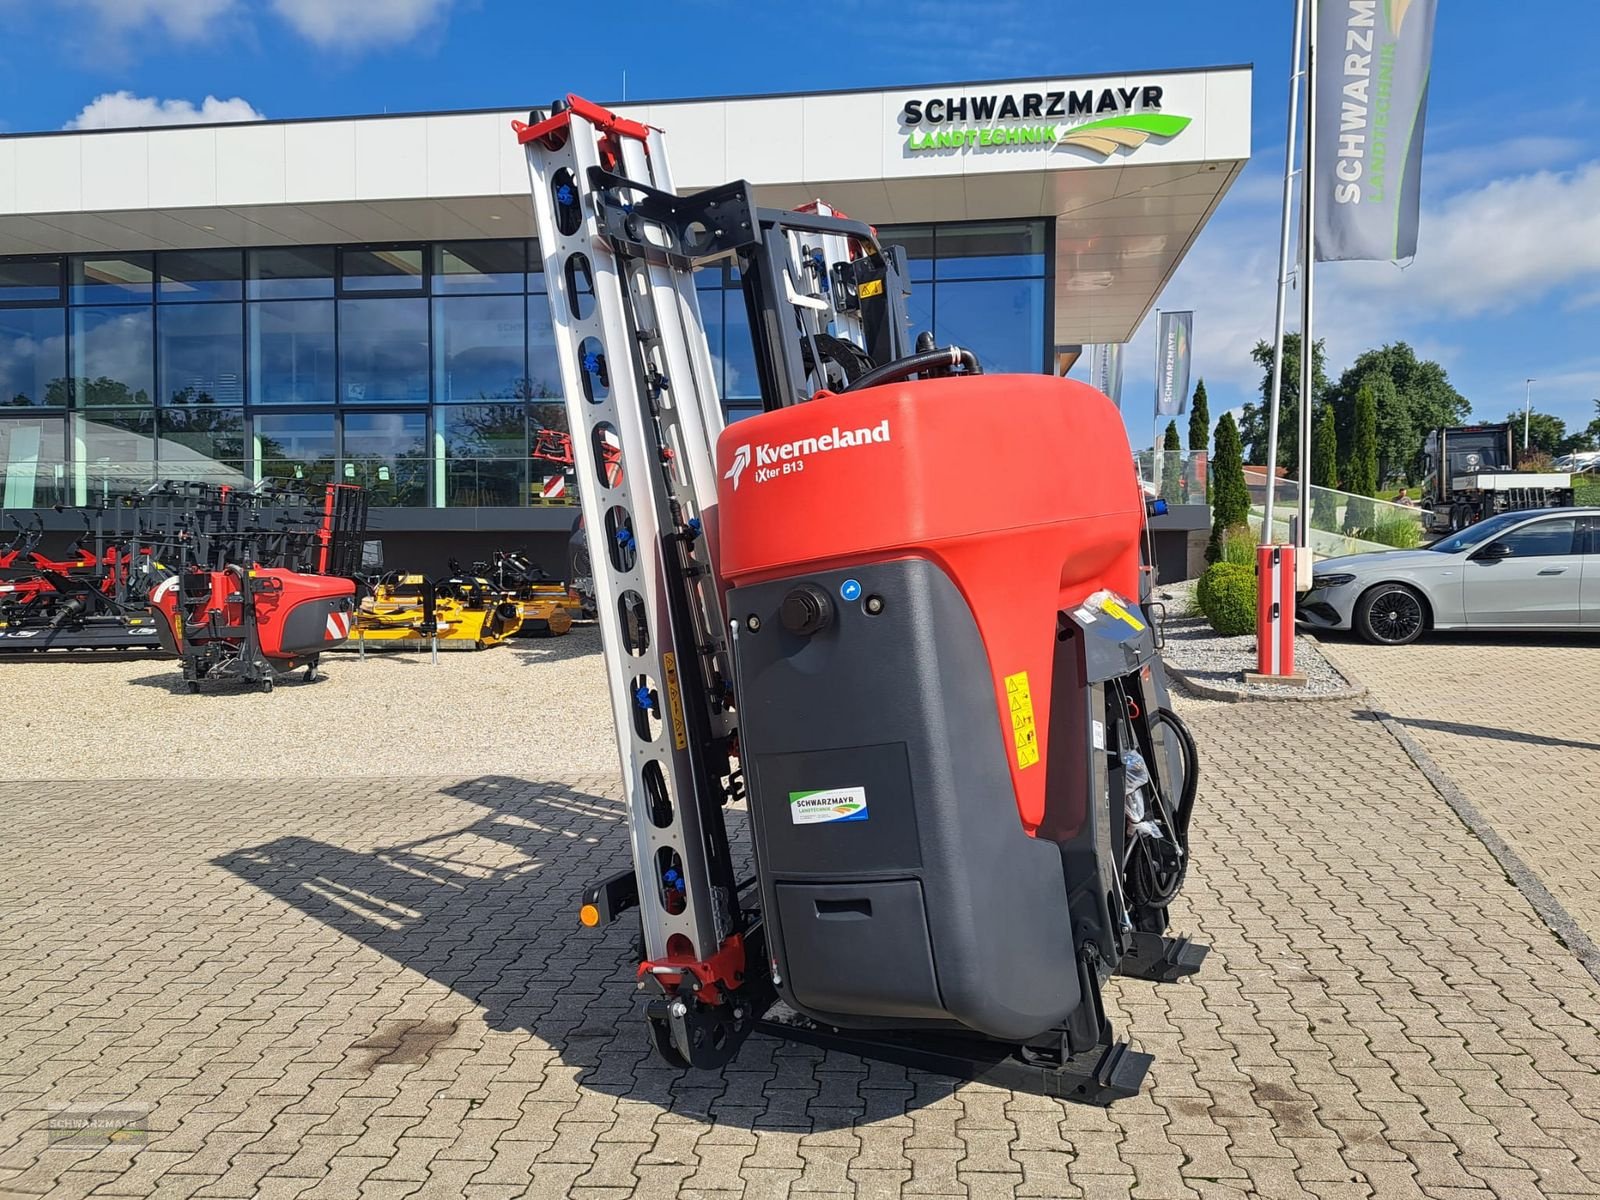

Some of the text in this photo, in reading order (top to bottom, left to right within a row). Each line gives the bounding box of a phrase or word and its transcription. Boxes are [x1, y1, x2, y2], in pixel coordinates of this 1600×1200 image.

[904, 85, 1163, 124] SCHWARZMAYR
[1368, 44, 1396, 203] LANDTECHNIK
[908, 126, 1057, 150] LANDTECHNIK
[1164, 332, 1176, 403] SCHWARZMAYR
[756, 420, 891, 467] Kverneland
[755, 460, 804, 483] iXter B13
[797, 797, 854, 807] SCHWARZMAYR
